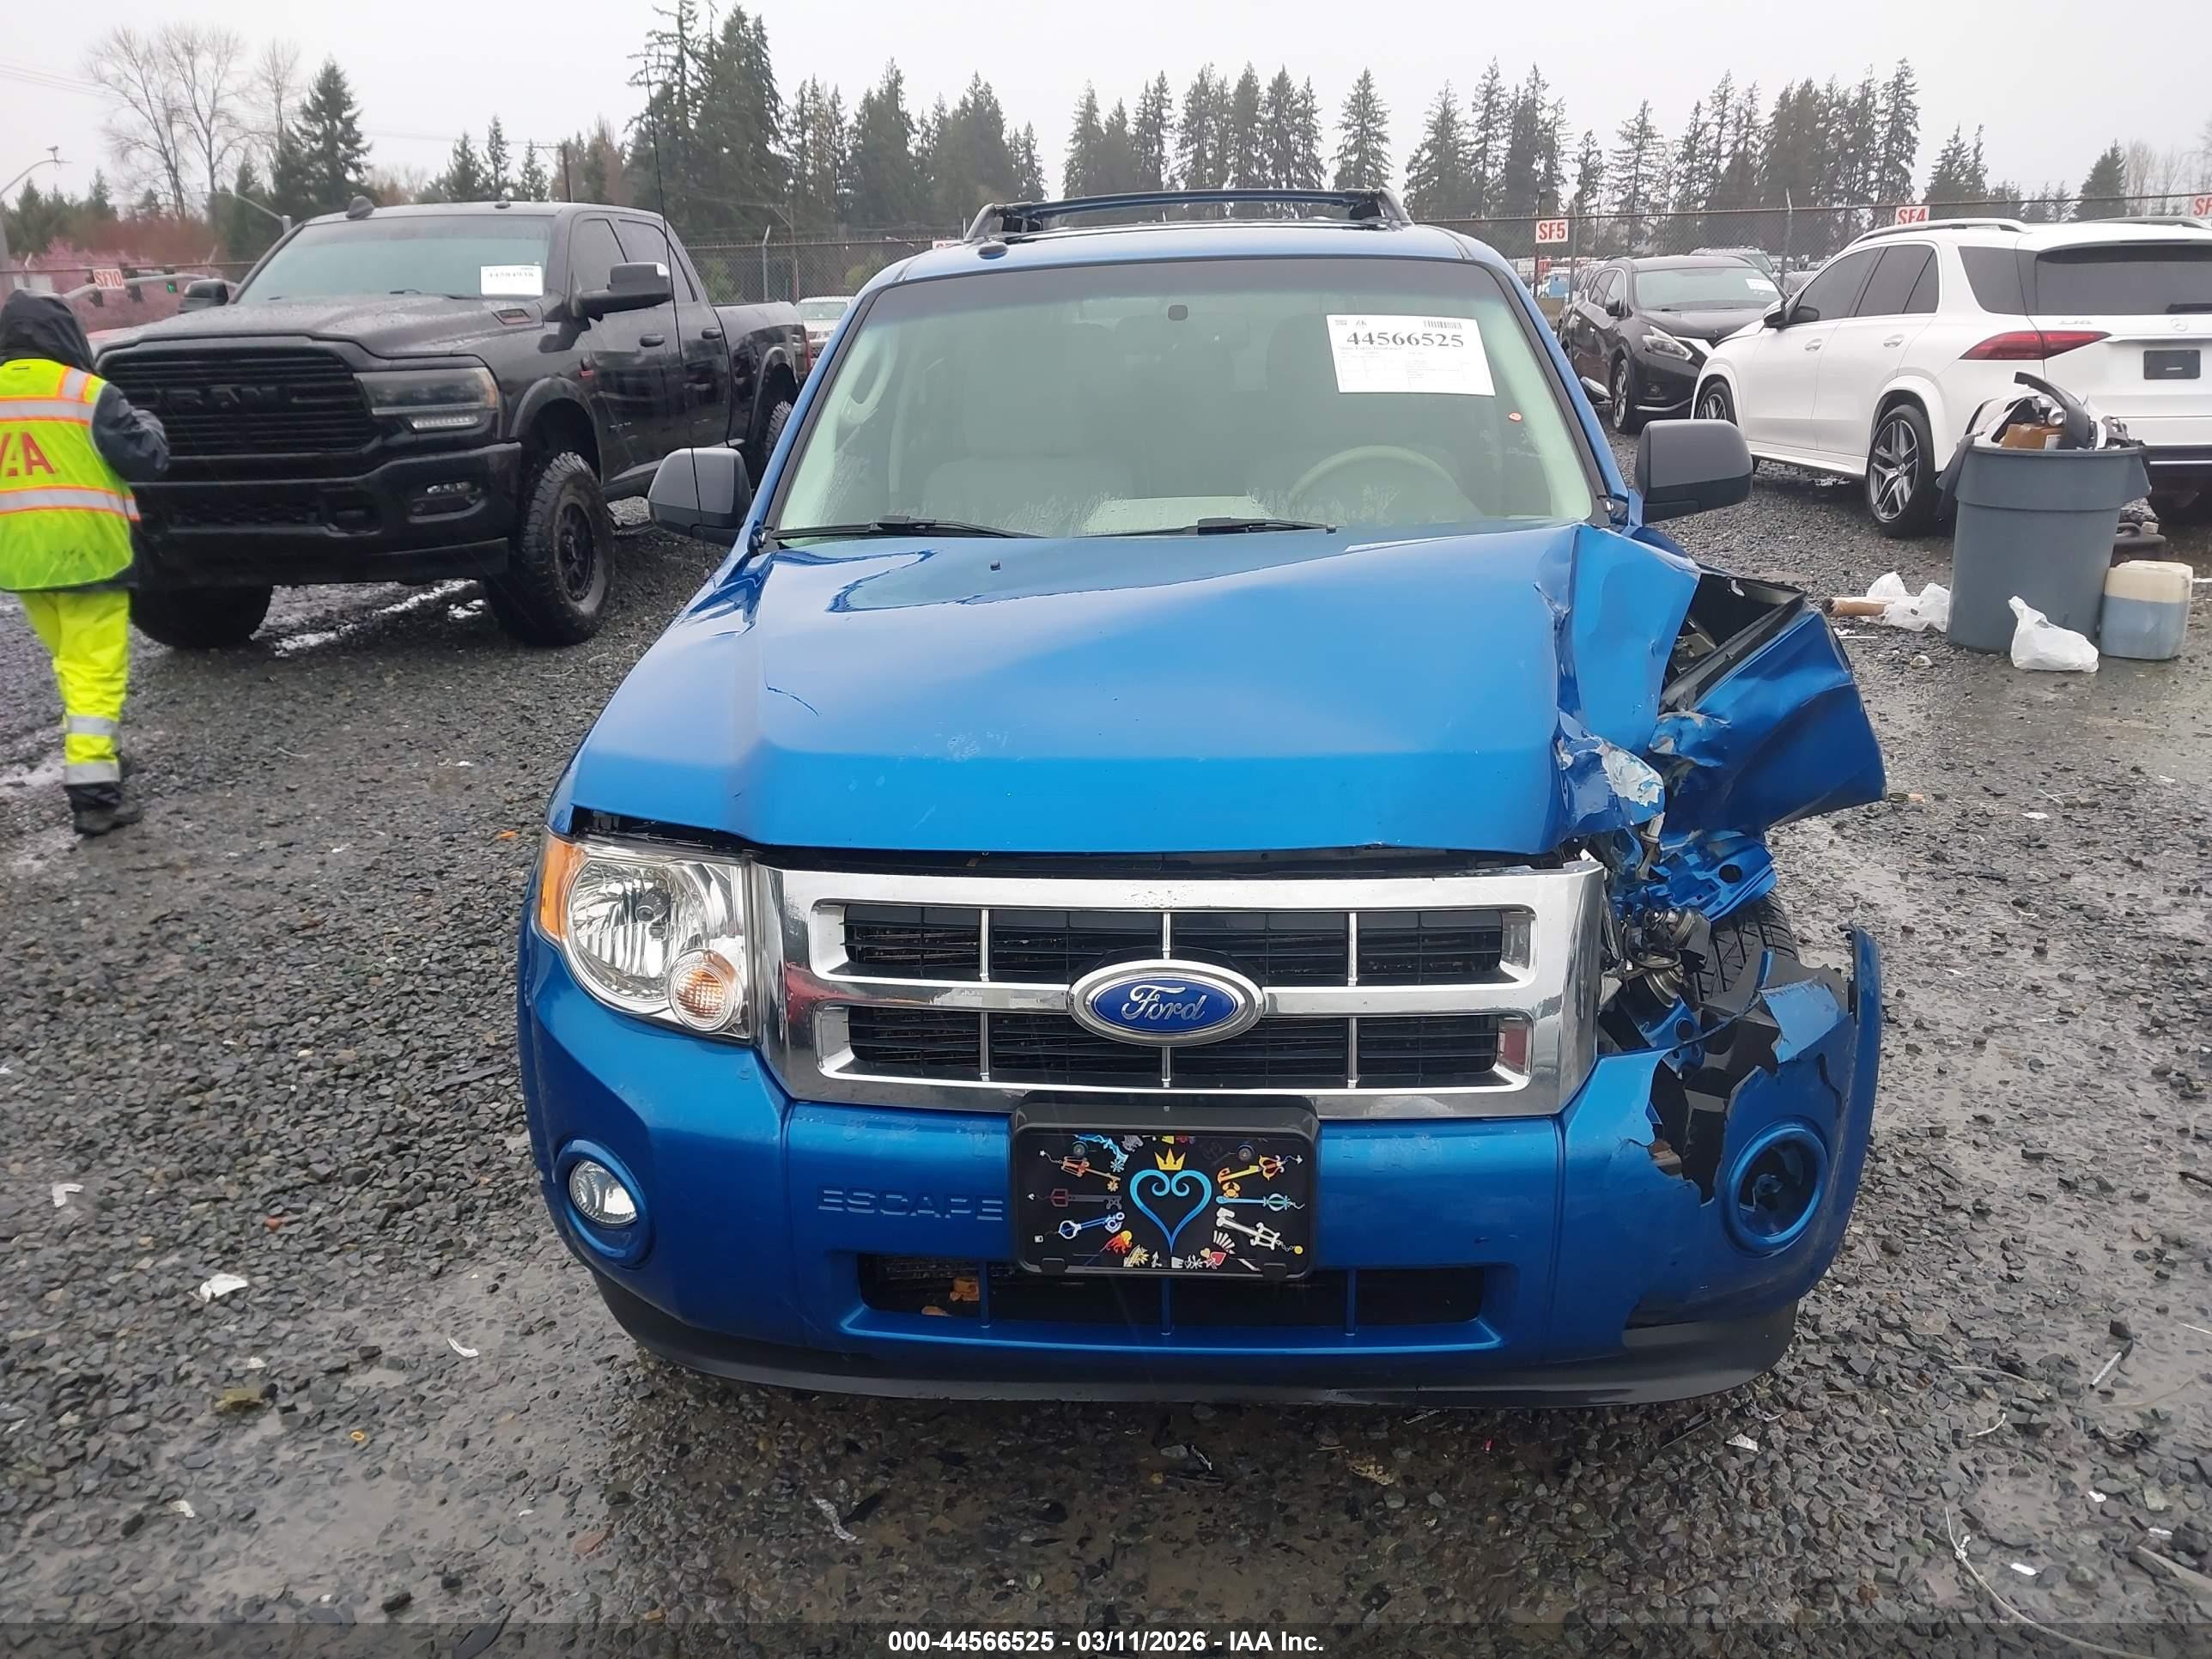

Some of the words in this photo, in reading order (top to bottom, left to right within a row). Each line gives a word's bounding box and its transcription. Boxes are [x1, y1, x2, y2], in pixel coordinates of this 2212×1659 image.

[1897, 208, 1926, 224] SF4
[1538, 222, 1566, 240] SF5
[95, 271, 123, 287] SF10
[1346, 331, 1464, 348] 44566525
[1121, 984, 1208, 1021] Ford
[817, 1188, 1005, 1221] ESCAPE
